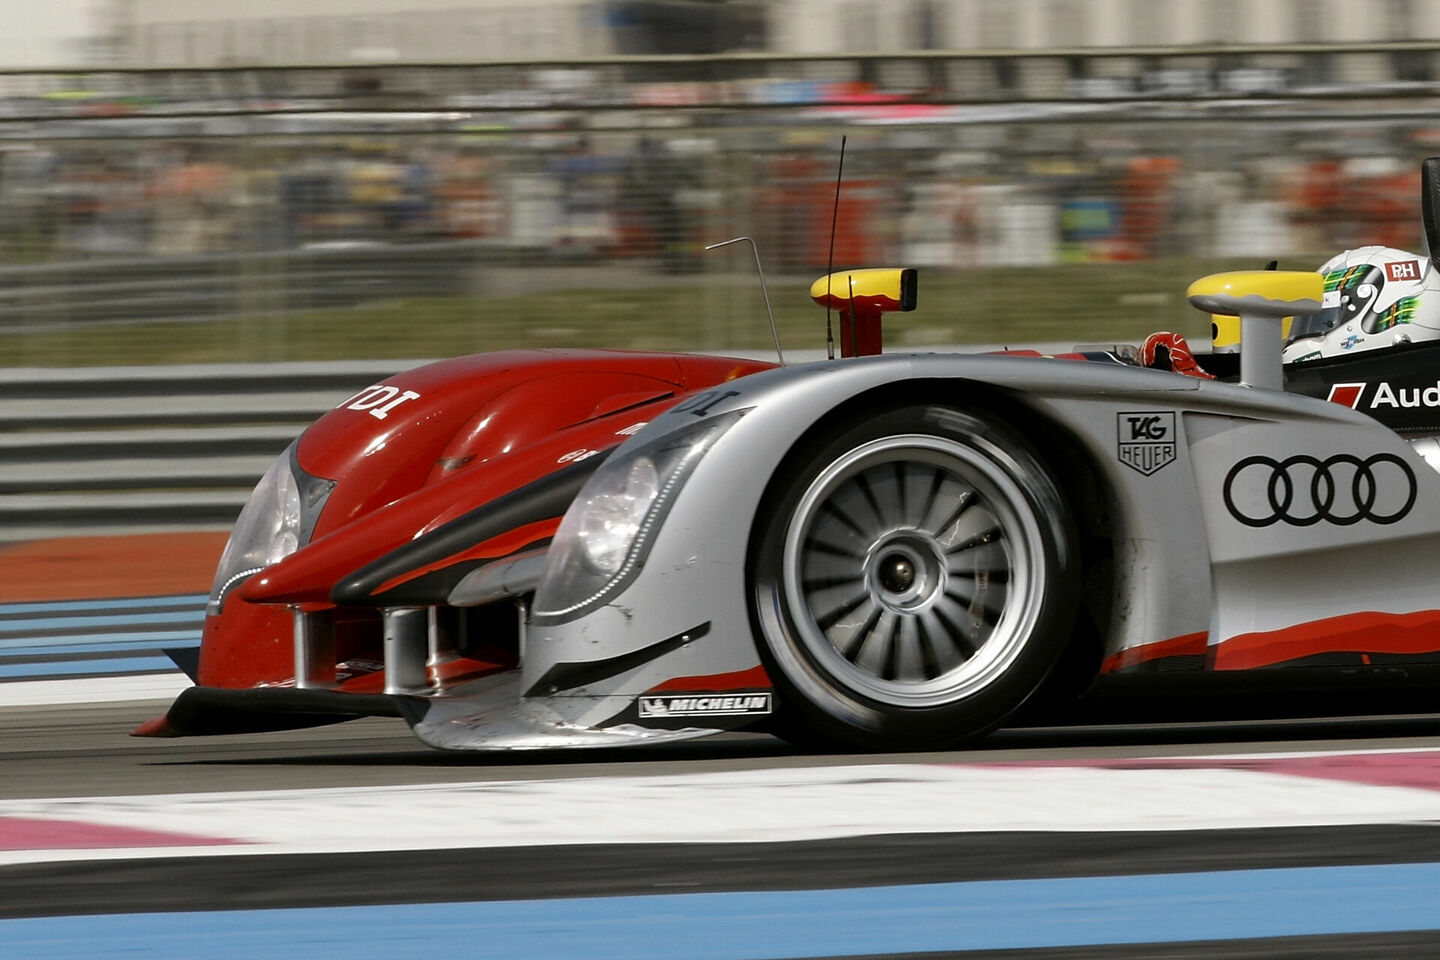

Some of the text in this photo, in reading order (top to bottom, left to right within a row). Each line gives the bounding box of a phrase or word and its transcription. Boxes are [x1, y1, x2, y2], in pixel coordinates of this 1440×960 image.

[1127, 416, 1167, 440] TAG
[1122, 446, 1172, 471] HEUER
[669, 697, 767, 711] MICHELIN
